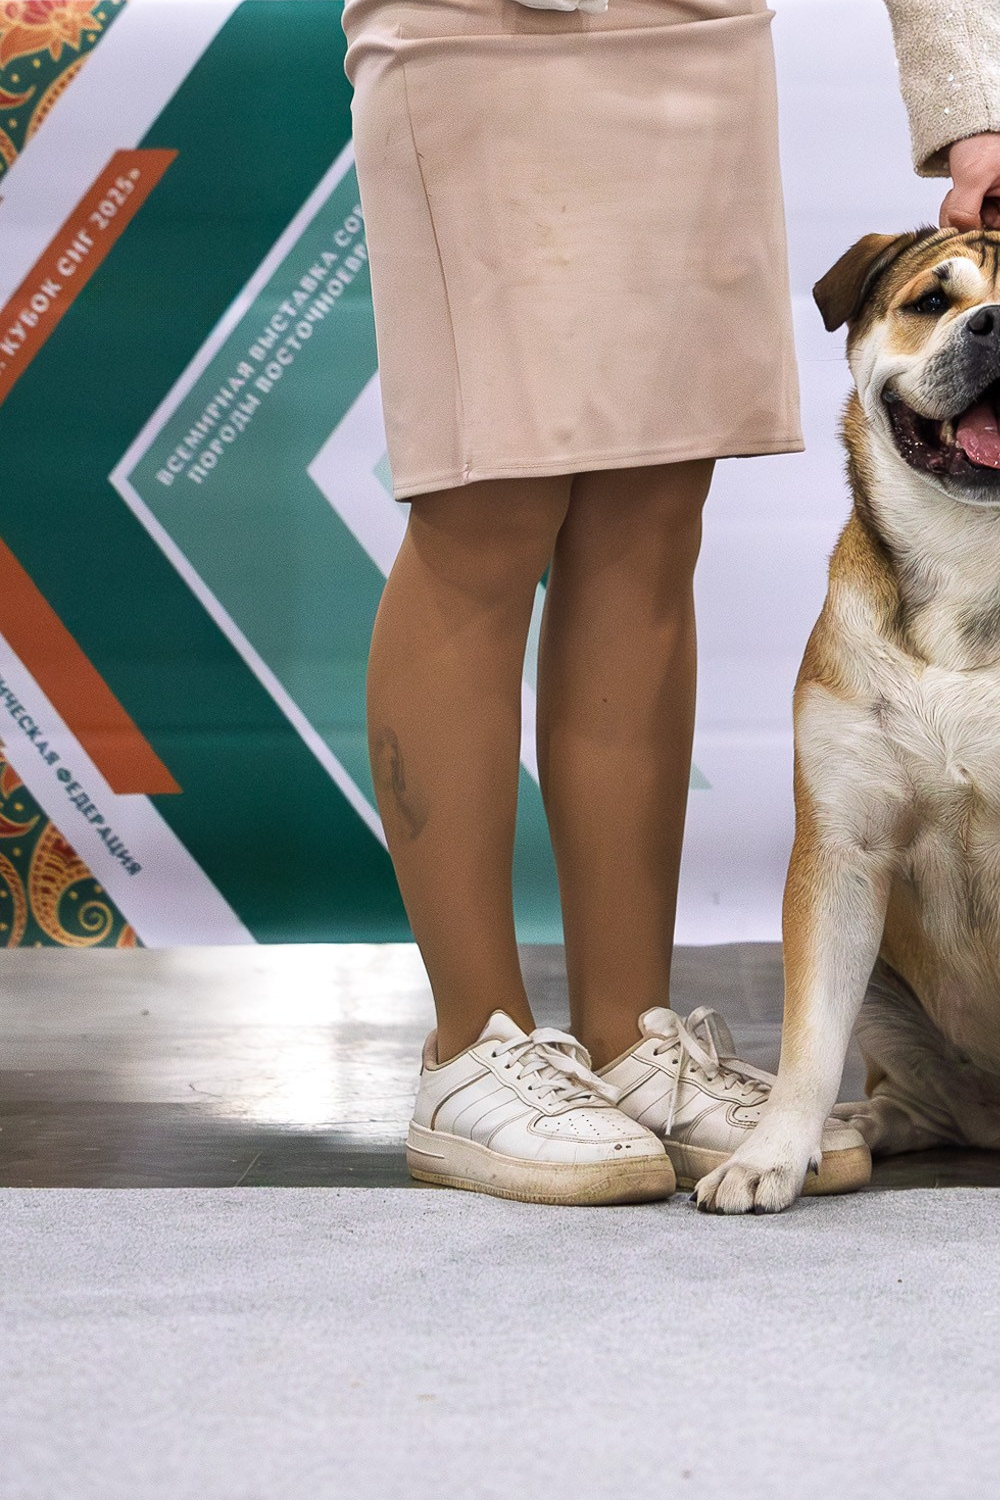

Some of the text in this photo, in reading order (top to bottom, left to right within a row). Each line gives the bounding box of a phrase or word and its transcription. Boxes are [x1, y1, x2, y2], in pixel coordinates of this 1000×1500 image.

[1, 278, 62, 356] КУБОК
[56, 227, 94, 277] СНГ
[155, 360, 255, 486] ВСЕМИРНАЯ
[249, 251, 338, 362] ВЫСТАВКА
[187, 393, 261, 484] ПОРОДЫ
[56, 767, 142, 877] ФЕДЕРАЦИЯ
